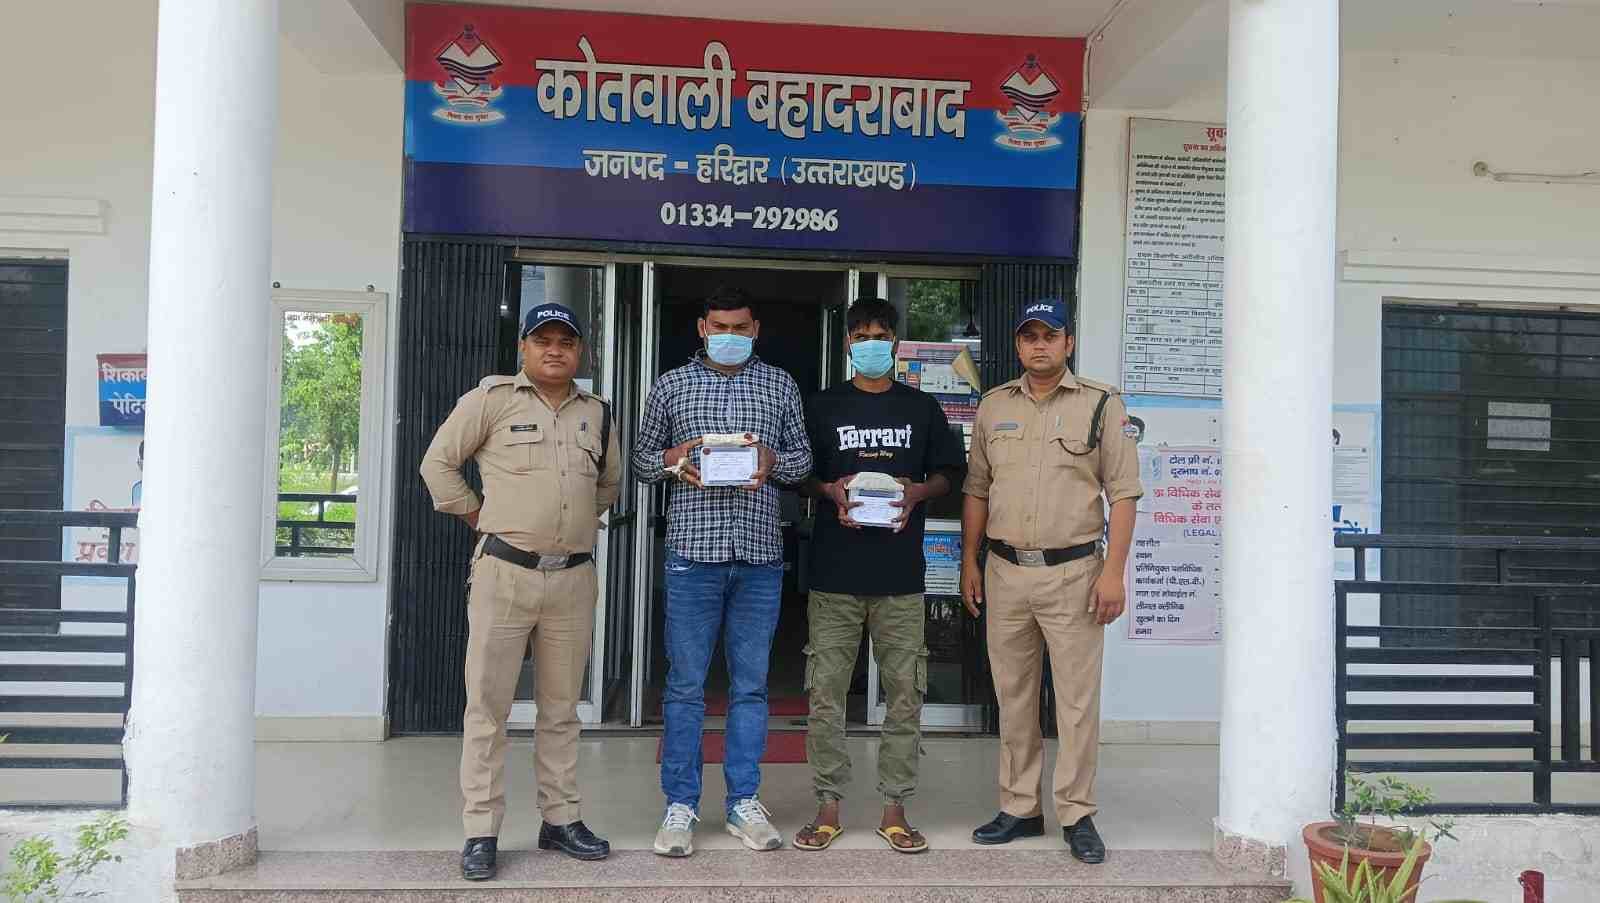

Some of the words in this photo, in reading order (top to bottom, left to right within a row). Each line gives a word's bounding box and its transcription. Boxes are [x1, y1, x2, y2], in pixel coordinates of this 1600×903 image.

[535, 36, 736, 130] कोतवाली
[746, 70, 971, 139] बहादराबाद
[582, 149, 671, 181] जनपद
[696, 143, 771, 186] हरिद्वार
[660, 201, 839, 232] 01334-292986
[537, 310, 570, 320] POLICE
[1026, 303, 1054, 314] POLICE
[836, 424, 912, 451] Ferrari
[1184, 529, 1217, 537] (LEGAL
